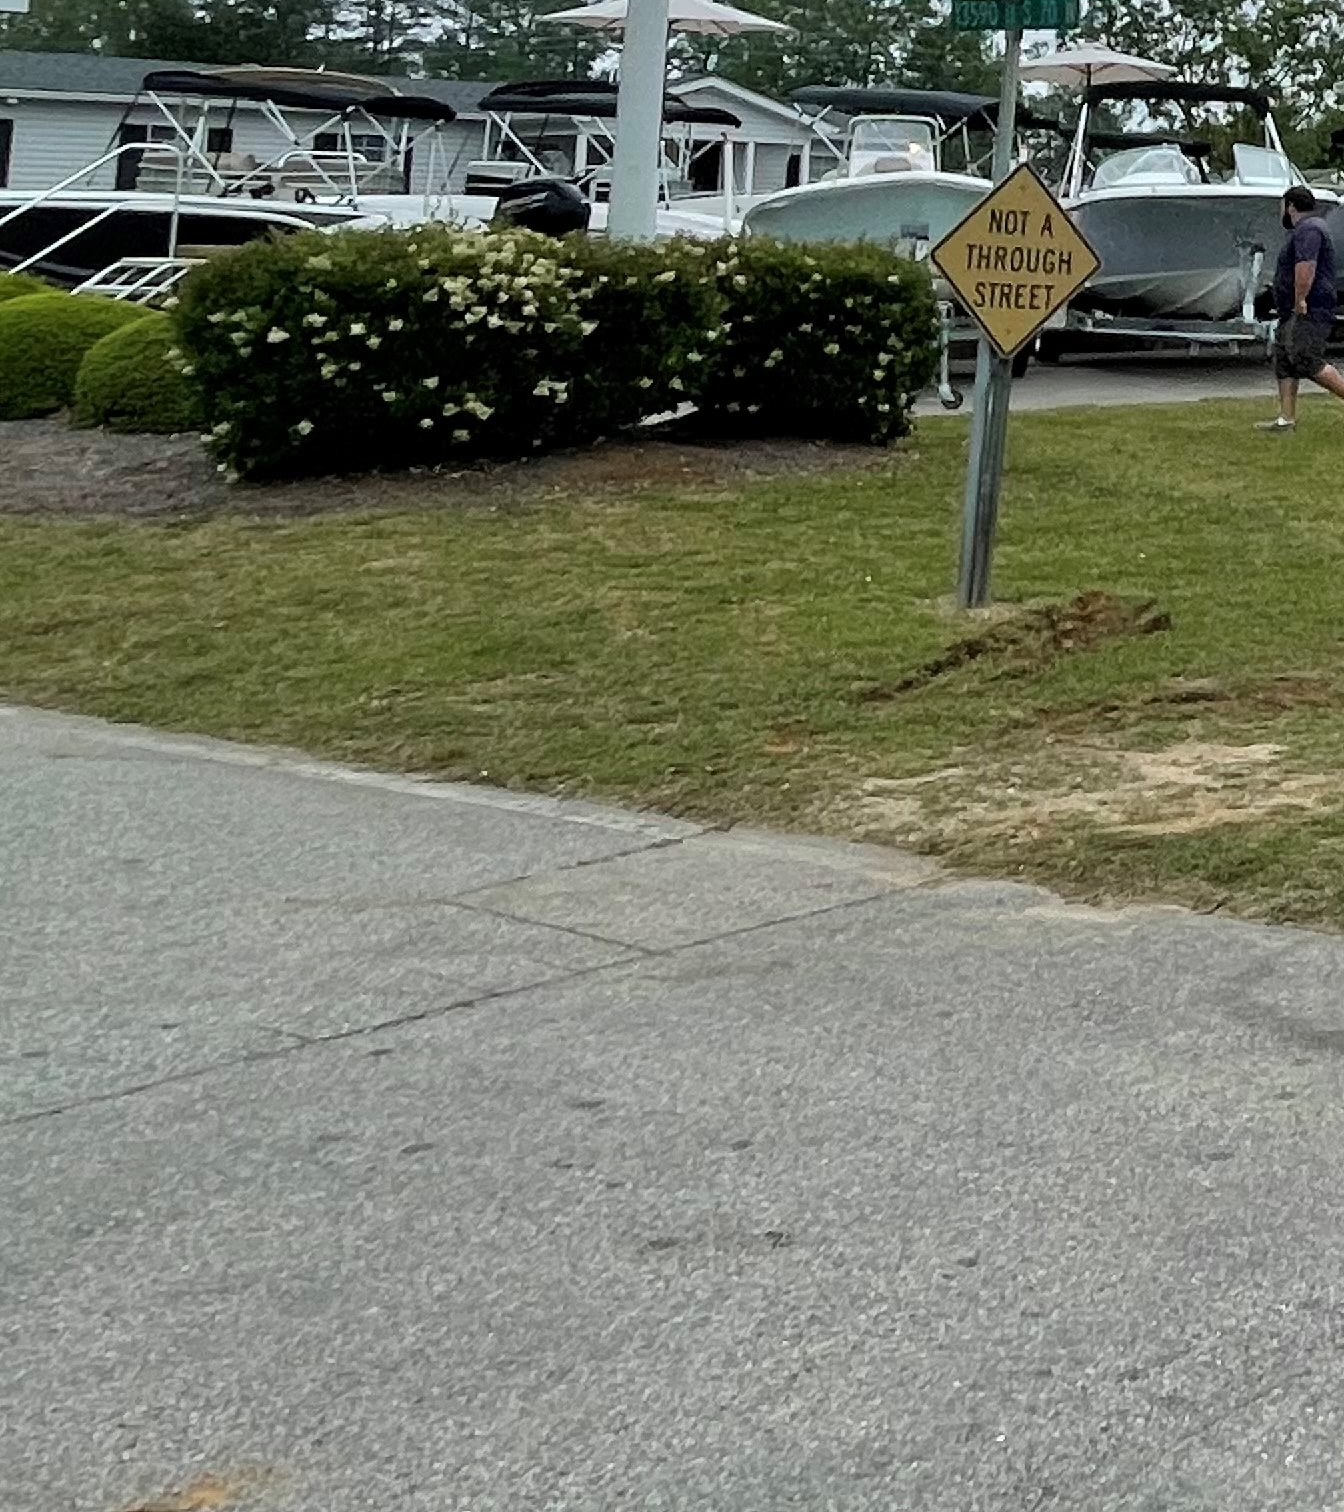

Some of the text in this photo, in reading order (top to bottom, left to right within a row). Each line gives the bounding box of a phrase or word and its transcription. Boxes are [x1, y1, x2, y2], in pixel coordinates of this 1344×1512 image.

[988, 208, 1054, 238] NOT A
[965, 242, 1073, 276] THROUGH
[972, 281, 1057, 311] STREET
